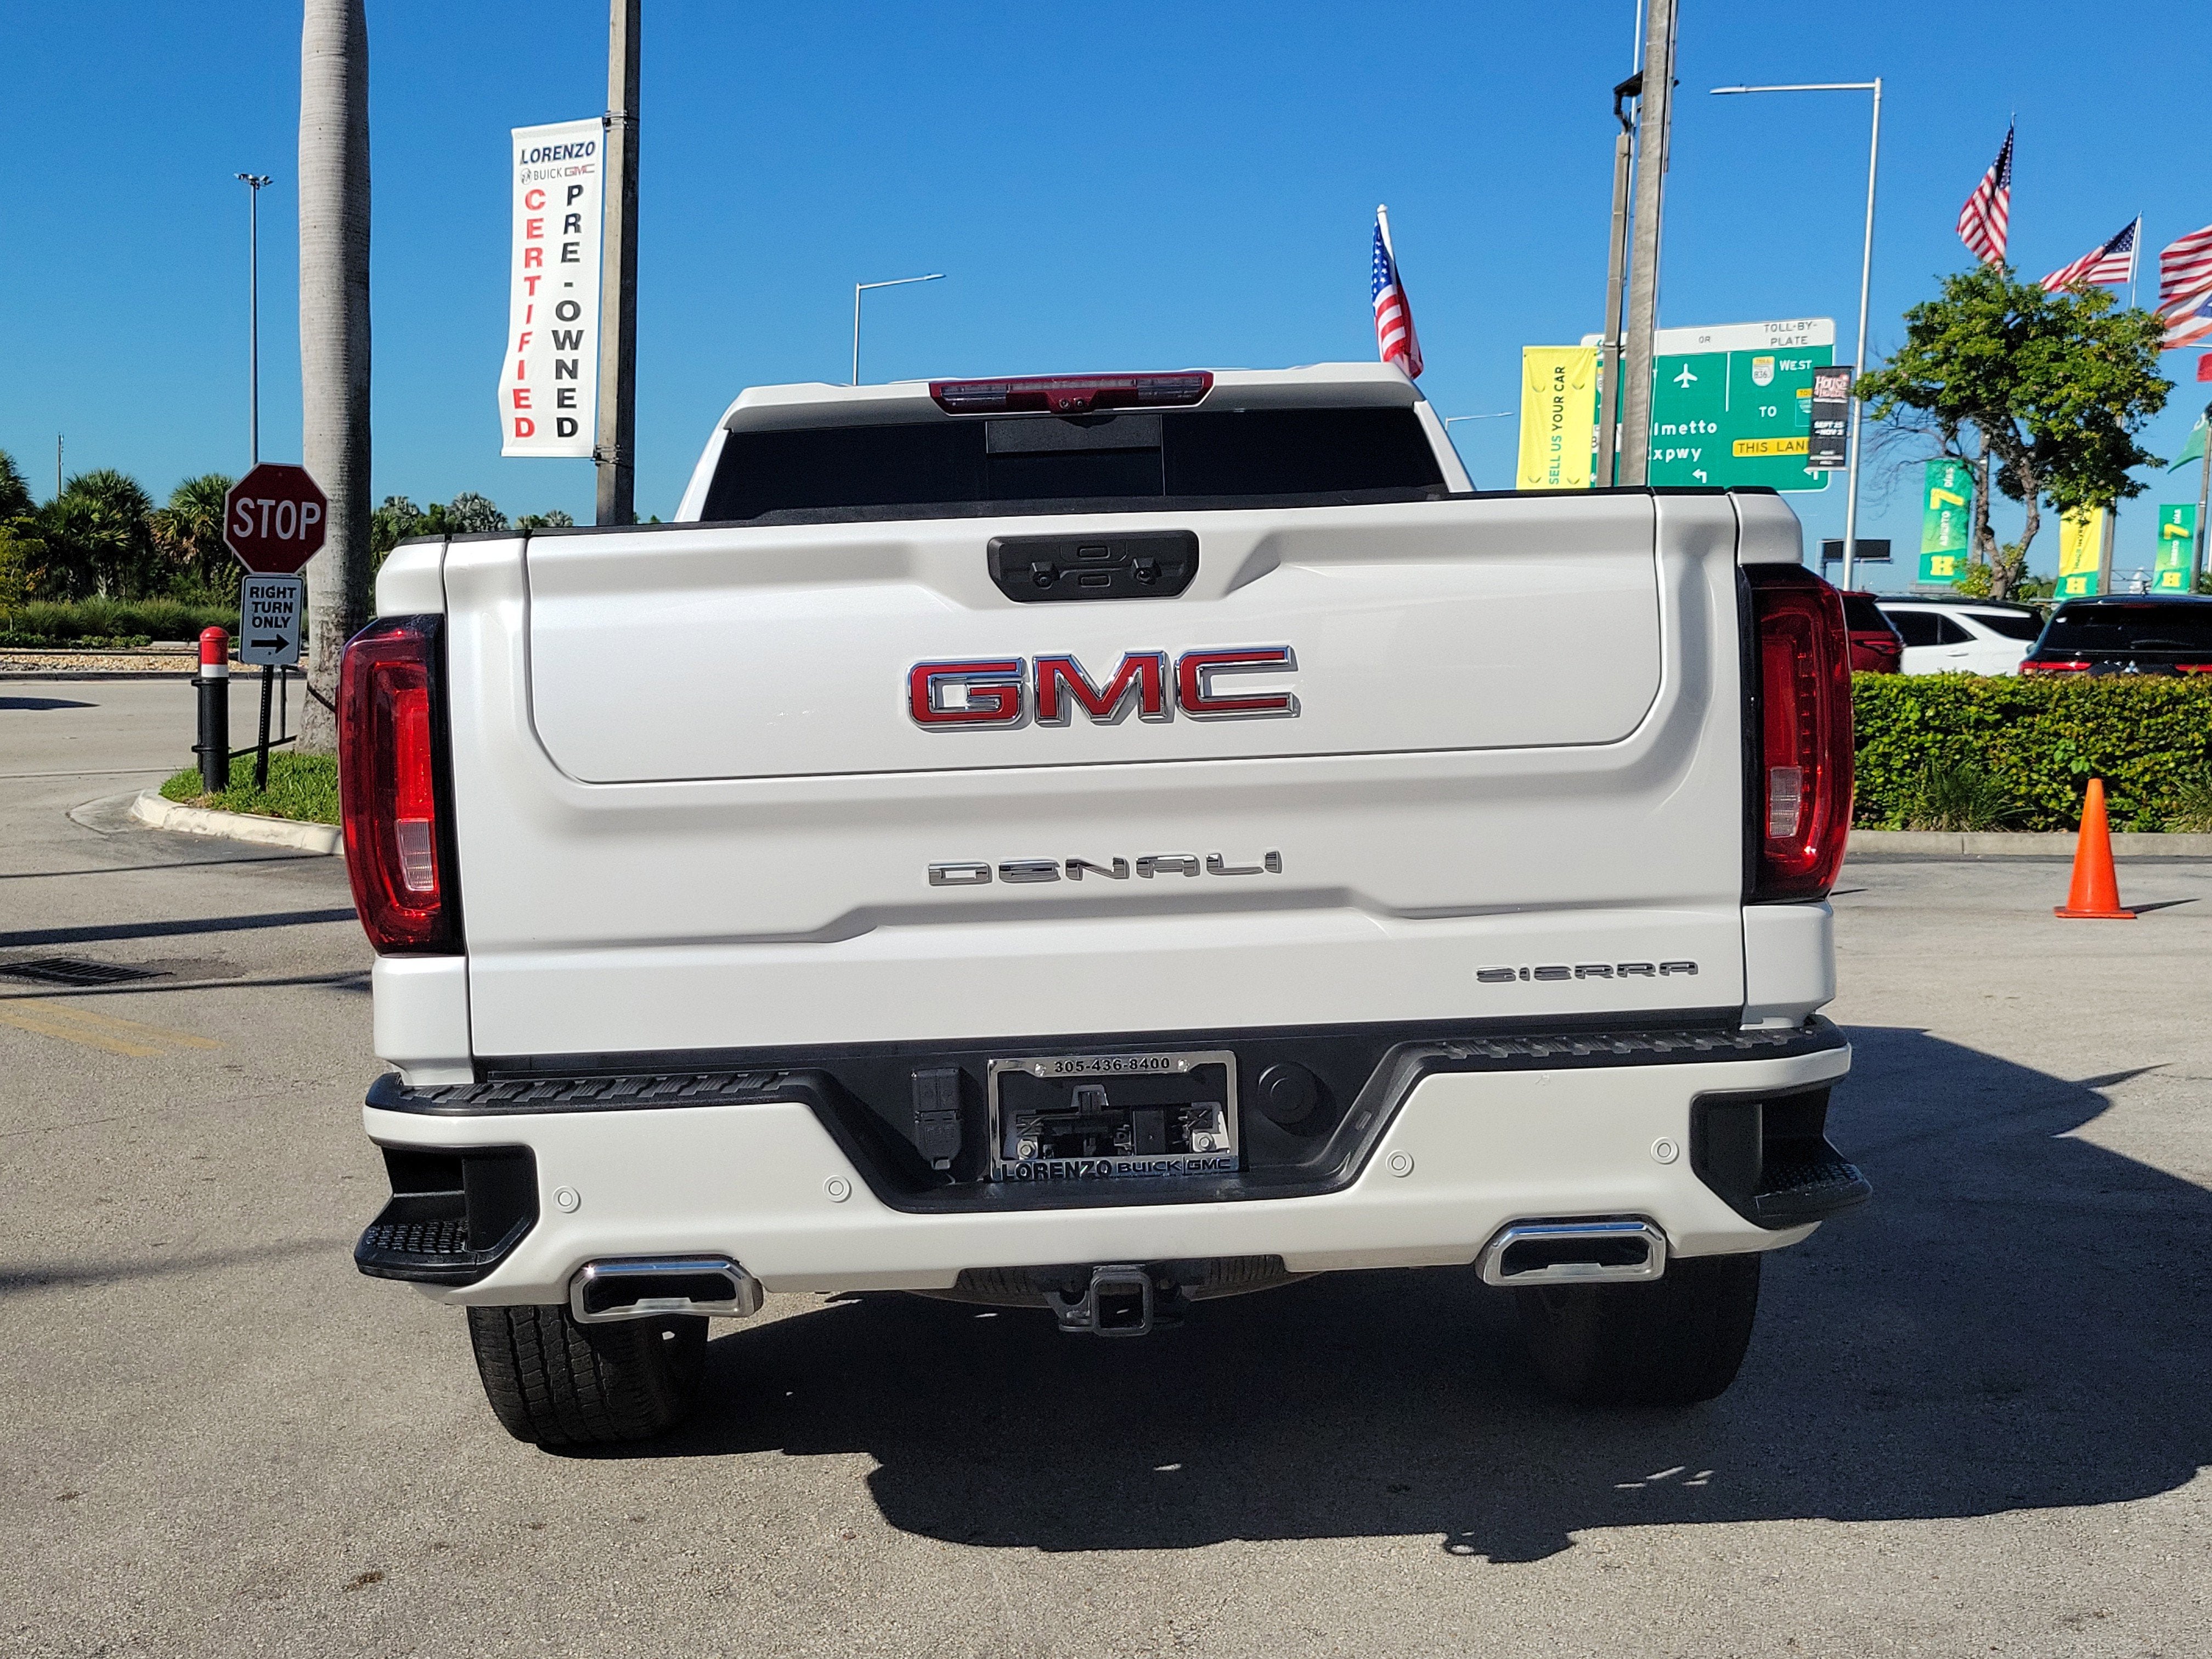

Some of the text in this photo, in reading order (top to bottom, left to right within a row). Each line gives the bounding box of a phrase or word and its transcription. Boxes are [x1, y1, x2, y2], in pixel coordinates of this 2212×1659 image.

[520, 141, 595, 165] LORENZO
[534, 163, 595, 180] BUICK GMC
[512, 189, 546, 438] CERTIFIED
[551, 184, 585, 438] PRE-OWNED
[1770, 336, 1808, 346] PLATE
[1779, 360, 1813, 371] WEST
[1759, 405, 1777, 417] TO
[1549, 366, 1565, 484] SELL US YOUR CAR
[1654, 420, 1717, 436] lmetto
[1649, 448, 1702, 463] xpwy
[1737, 442, 1768, 454] THIS
[1930, 488, 1964, 510] 7
[233, 497, 321, 540] STOP
[2164, 523, 2189, 540] 7
[250, 585, 297, 599] RIGHT
[252, 601, 293, 614] TURN
[251, 616, 291, 629] ONLY
[907, 645, 1300, 730] GMC
[928, 850, 1282, 887] DENALI
[1476, 961, 1699, 983] SIERRA
[1054, 1057, 1170, 1073] 305-436-8400
[1000, 1158, 1232, 1182] LORENZO BUICK GMC
